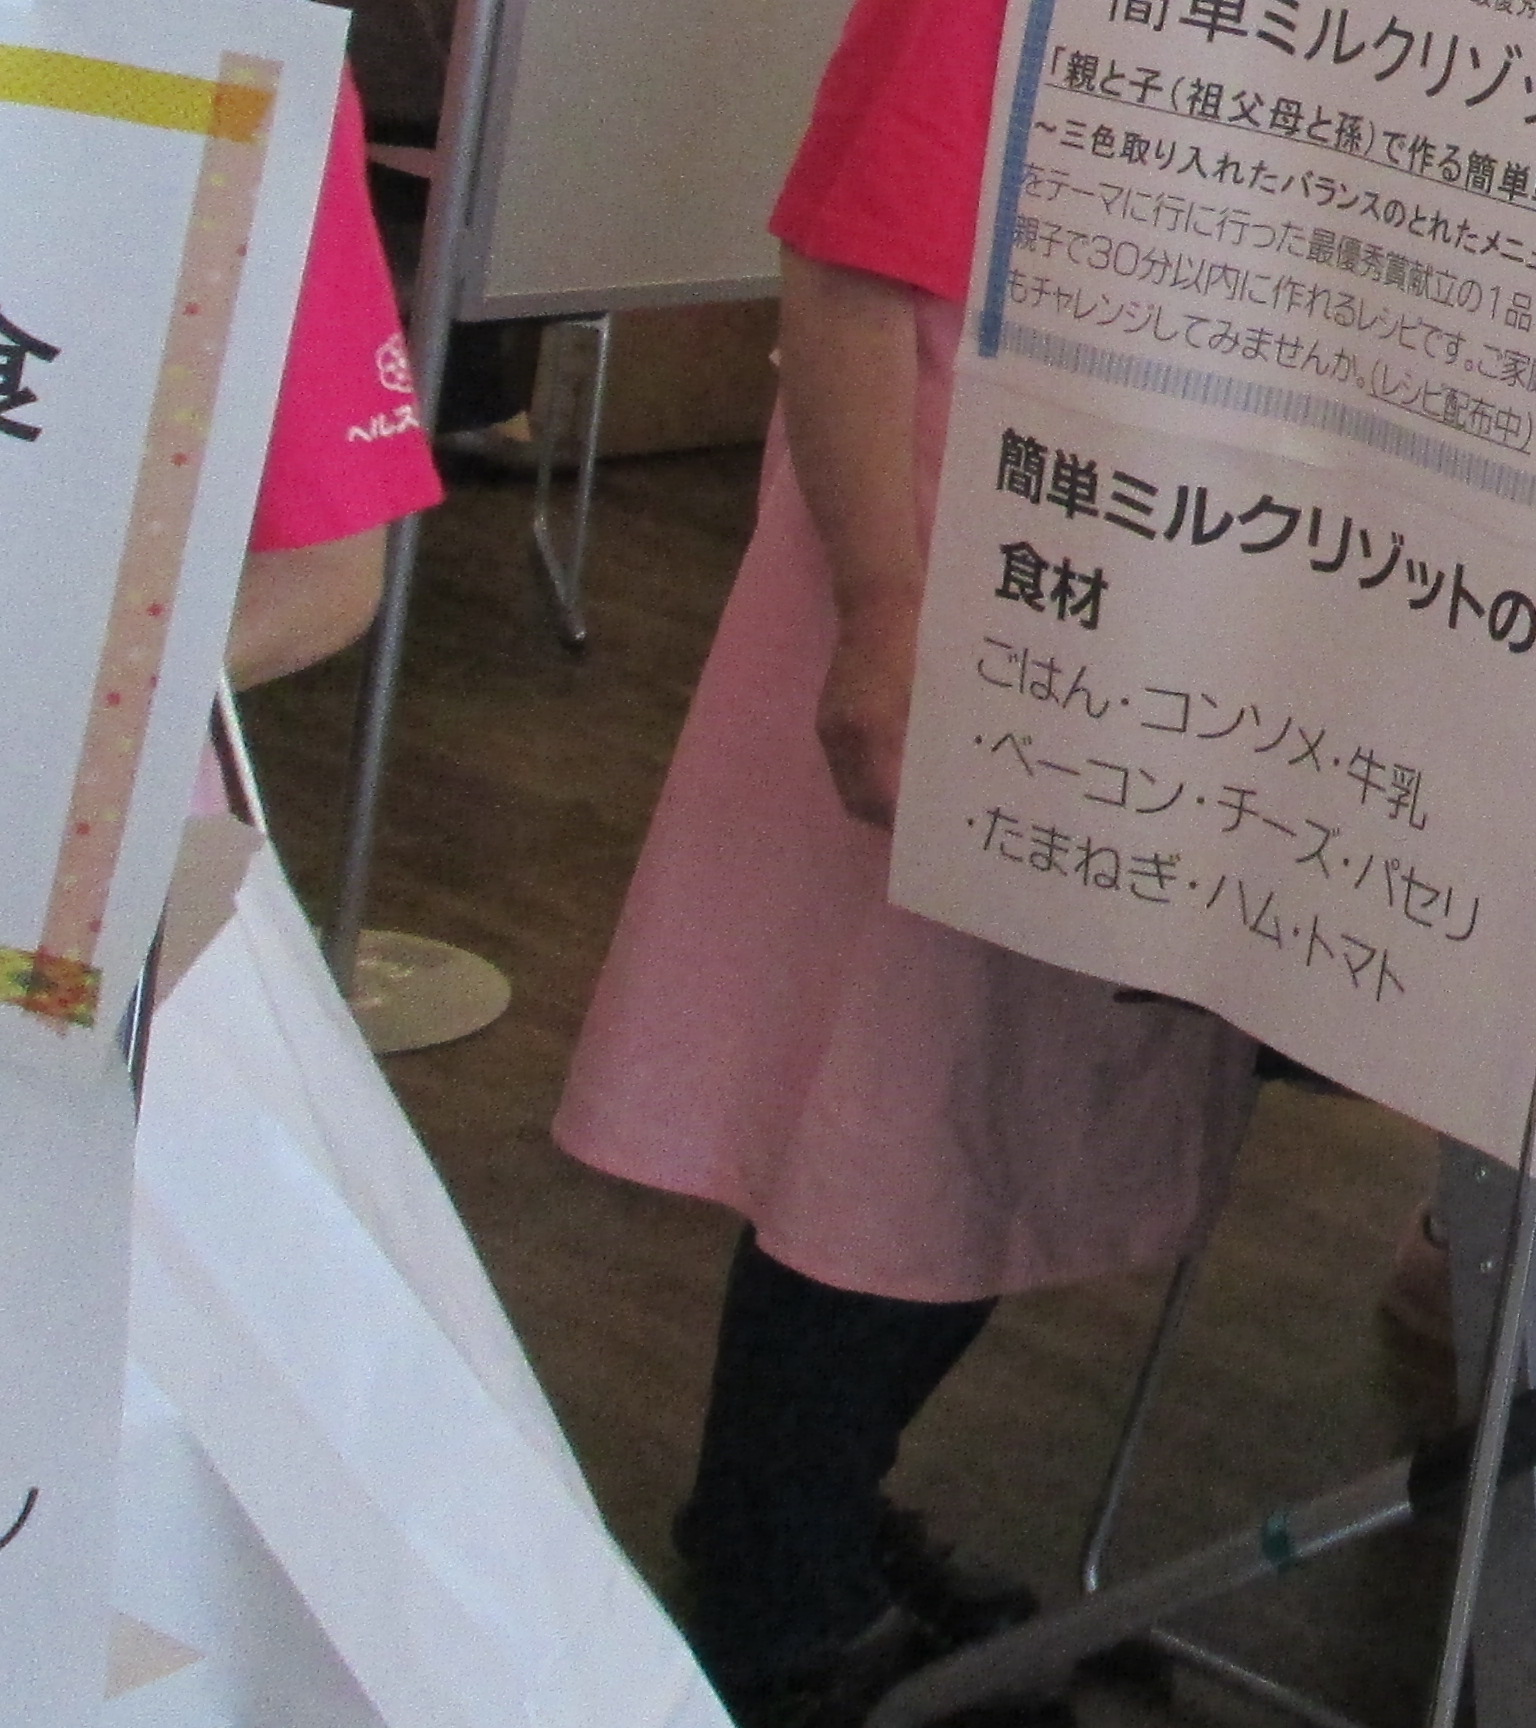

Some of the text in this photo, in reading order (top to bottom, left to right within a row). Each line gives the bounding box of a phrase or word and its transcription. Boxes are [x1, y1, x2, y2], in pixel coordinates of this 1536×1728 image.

[995, 540, 1108, 631] 食材
[977, 636, 1427, 832] ごはん・コンソメ・牛乳
